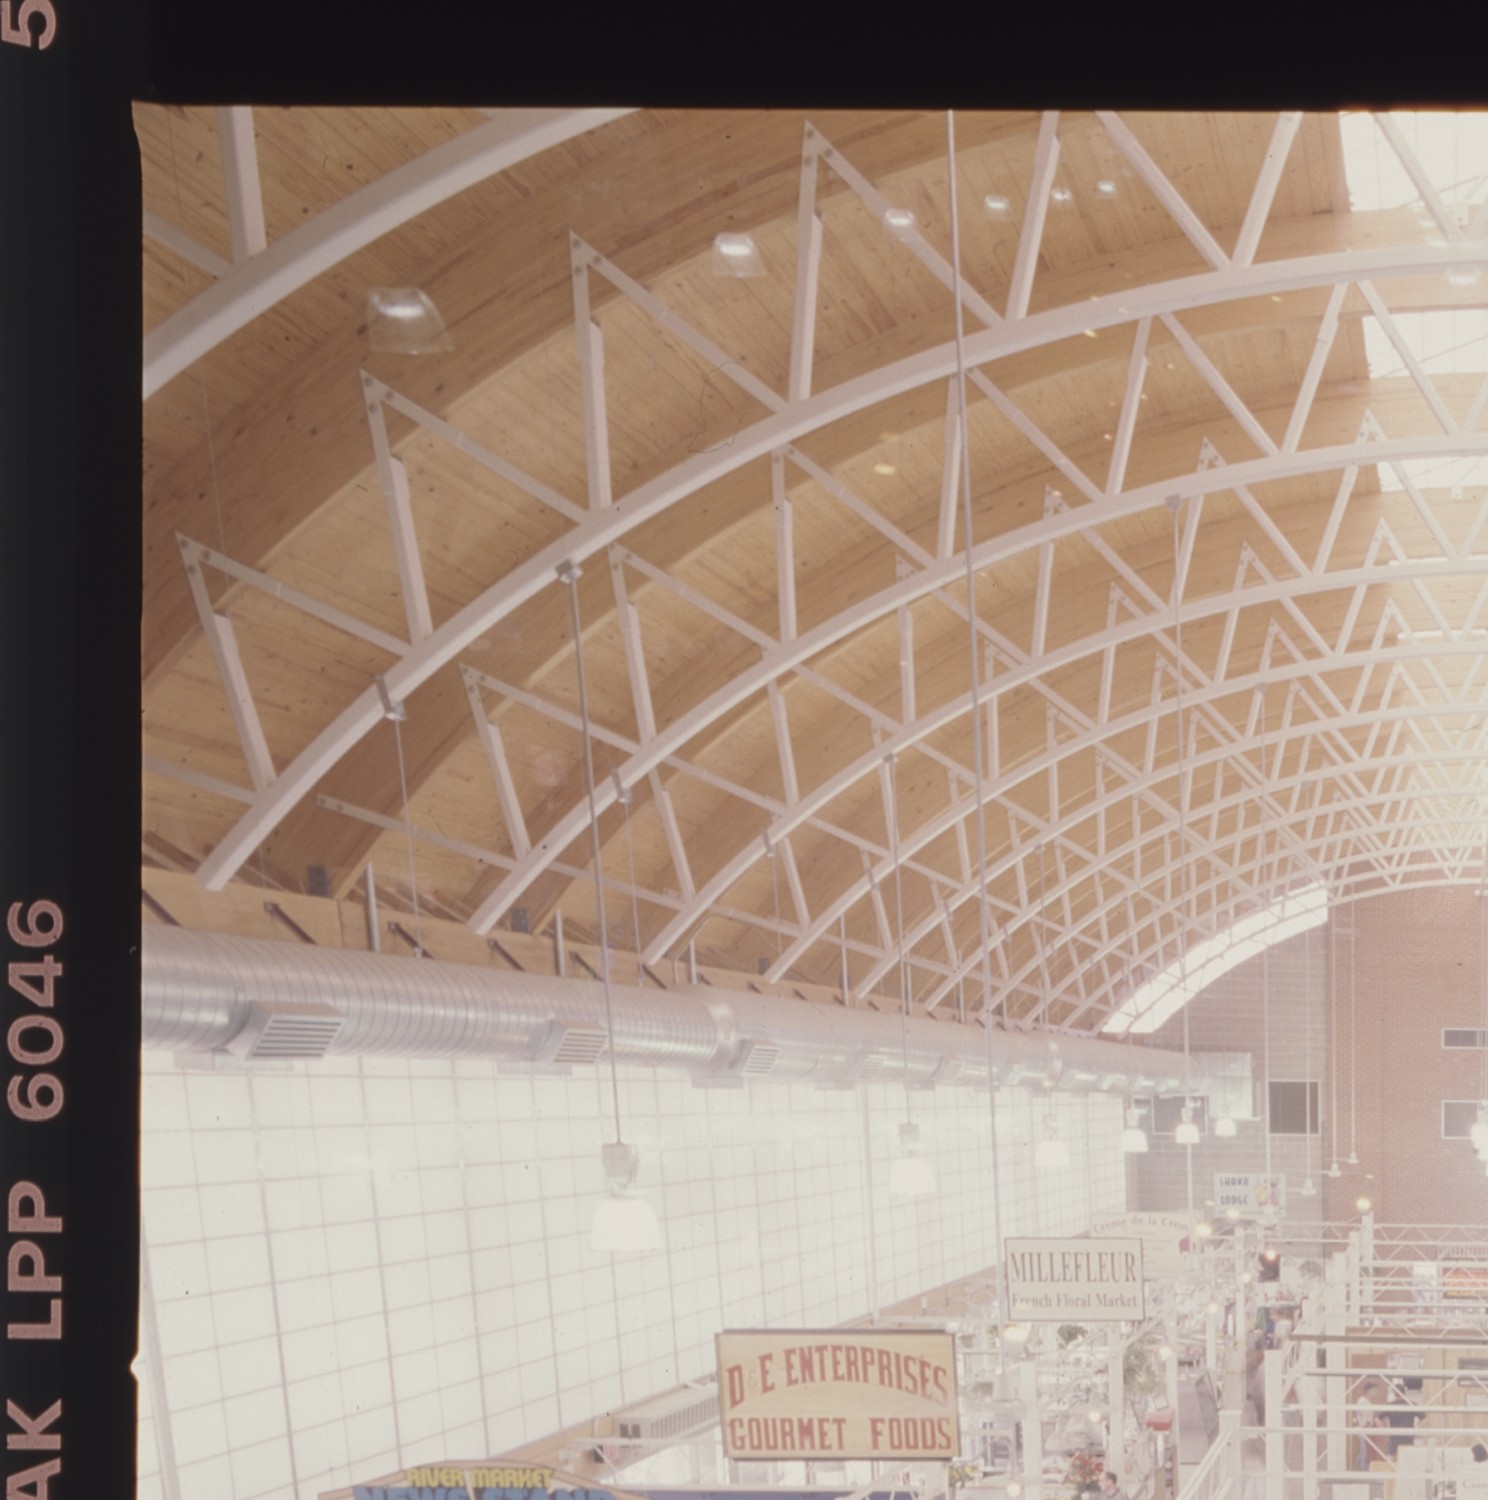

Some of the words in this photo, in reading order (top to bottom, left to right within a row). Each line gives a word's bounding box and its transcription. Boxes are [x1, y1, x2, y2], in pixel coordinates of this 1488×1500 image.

[7, 900, 65, 1122] 6046
[1093, 1218, 1126, 1234] Creme
[1131, 1215, 1146, 1226] de
[1148, 1215, 1158, 1226] la
[1161, 1217, 1193, 1233] Crem
[7, 1181, 63, 1340] LPP
[1010, 1252, 1137, 1283] MILLEFLEUR
[1012, 1294, 1052, 1308] French
[1056, 1293, 1091, 1308] Floral
[1096, 1293, 1137, 1308] Market
[783, 1344, 949, 1408] ENTERPRISES
[729, 1417, 847, 1451] GOURMET
[869, 1417, 952, 1451] FOODS
[405, 1468, 464, 1489] RIVER
[469, 1466, 554, 1489] MARKET
